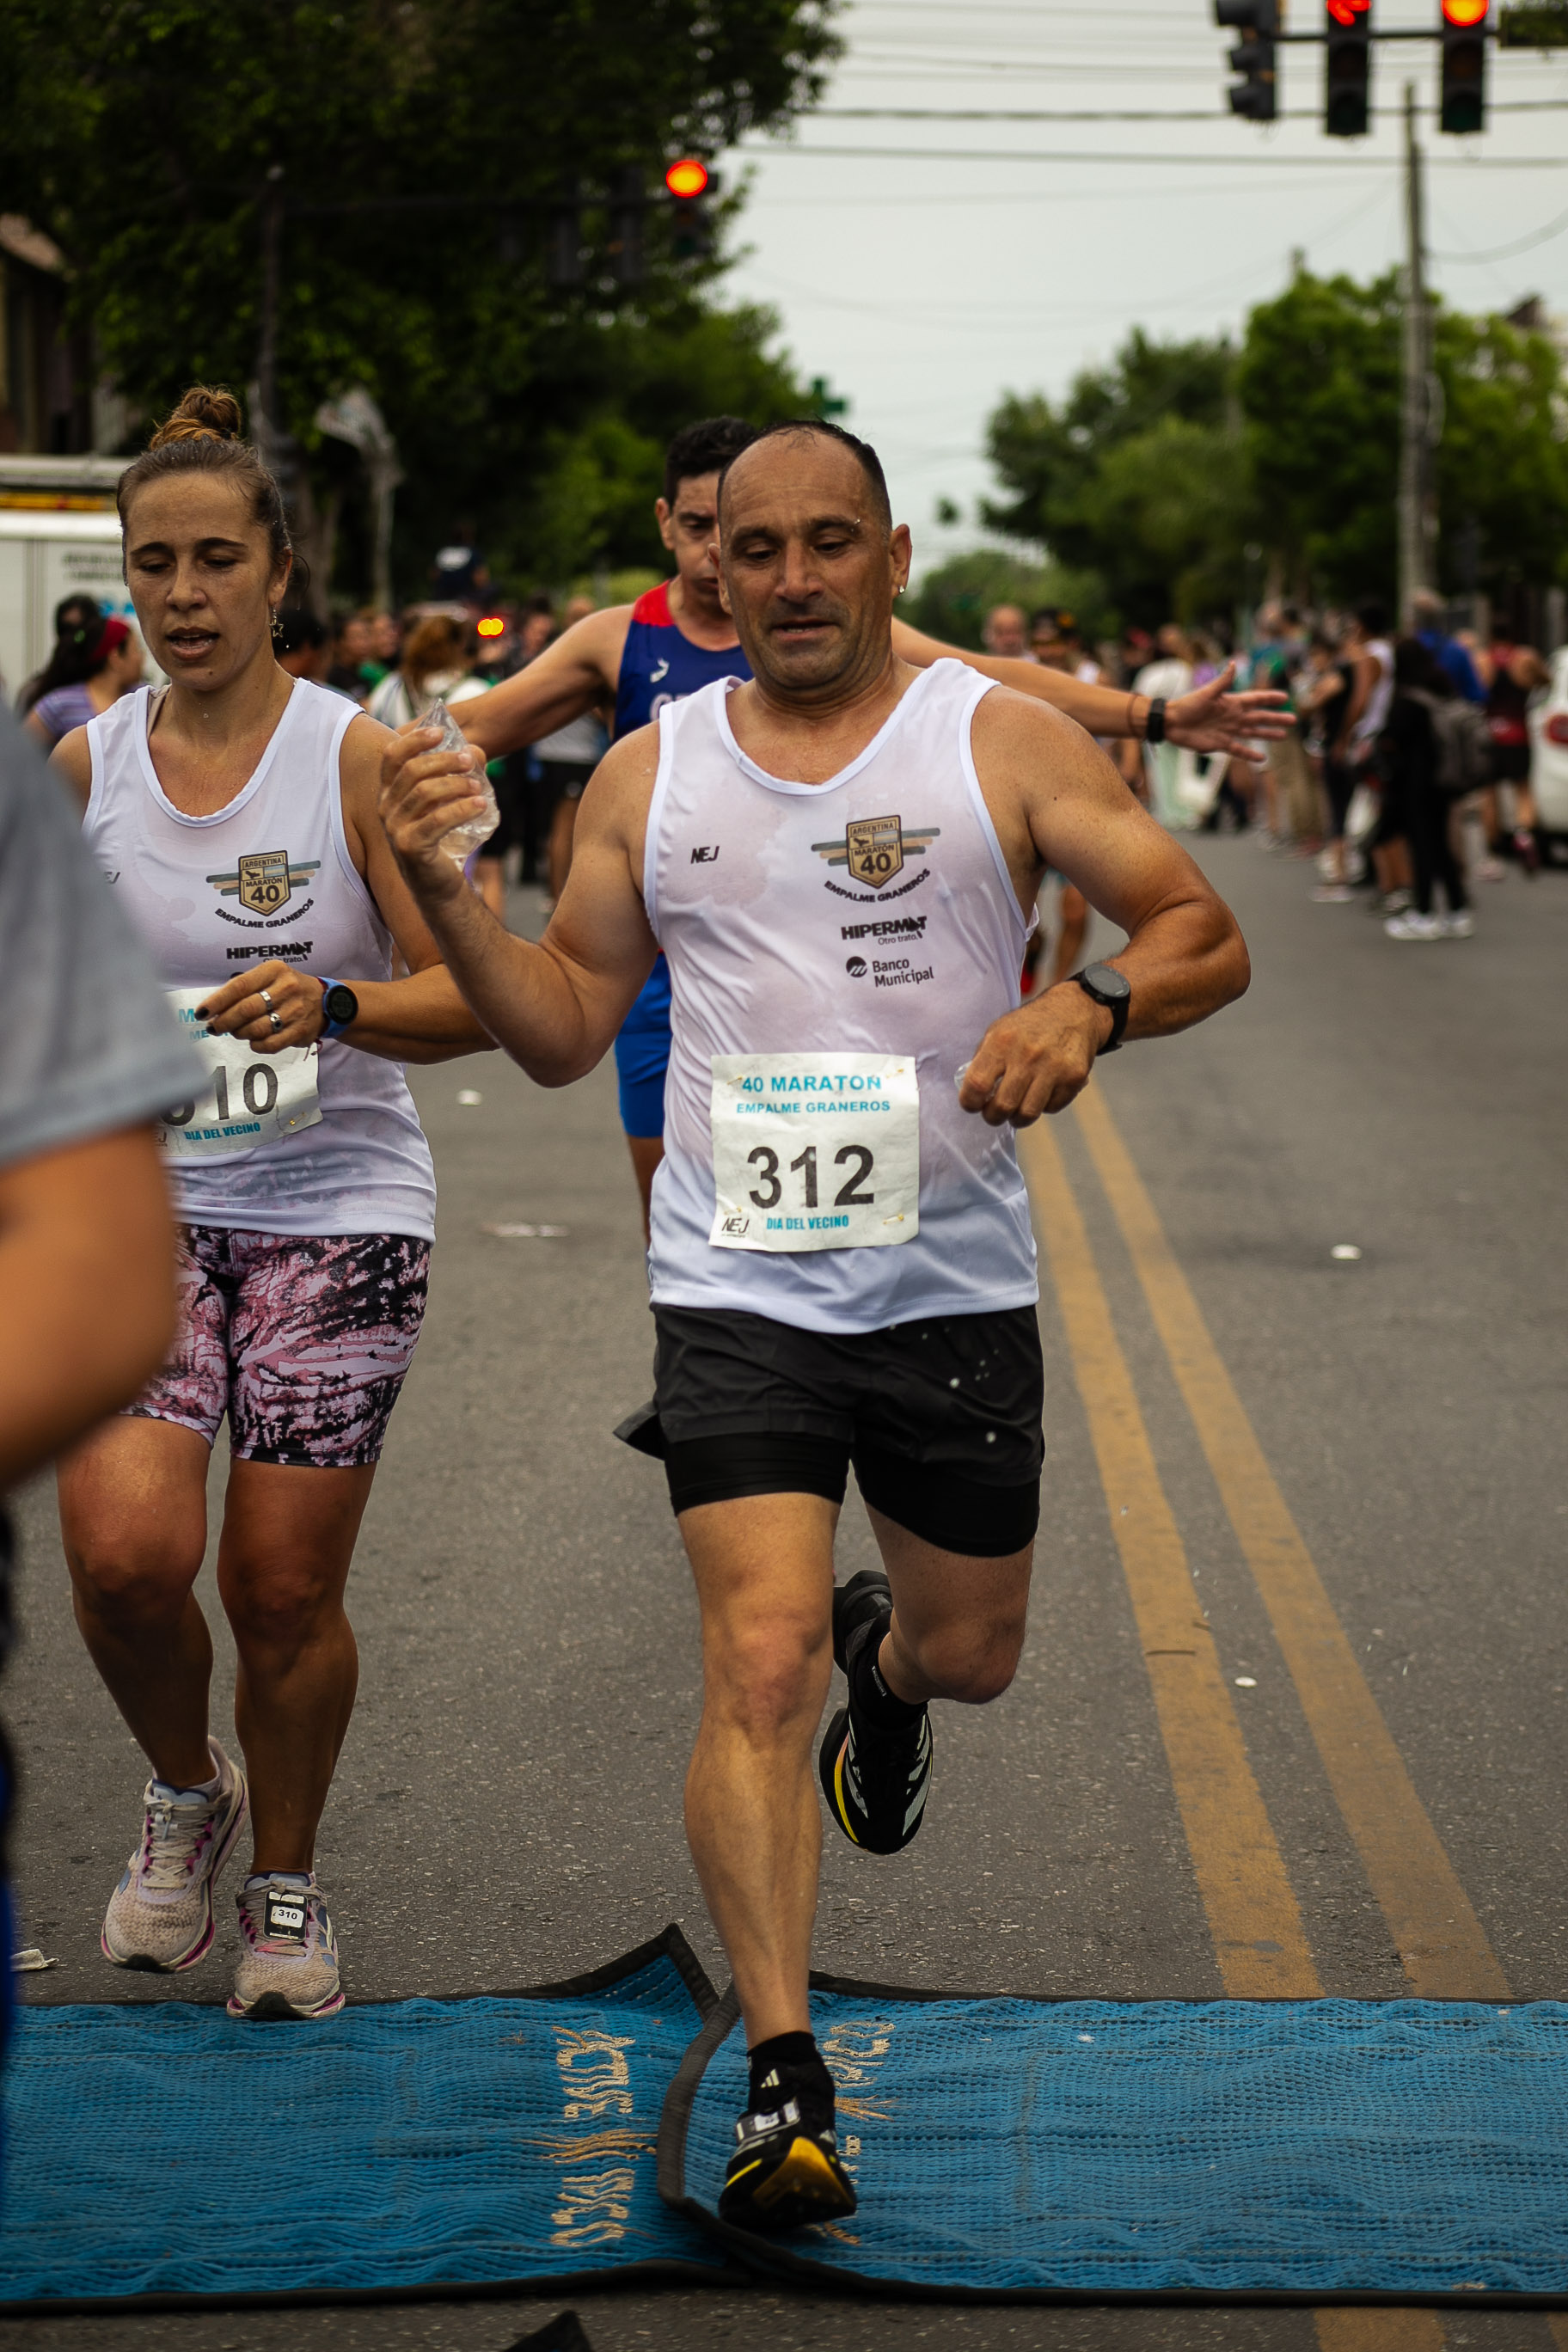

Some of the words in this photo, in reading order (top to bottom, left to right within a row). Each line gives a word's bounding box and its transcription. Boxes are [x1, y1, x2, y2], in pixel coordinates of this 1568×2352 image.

[852, 822, 894, 835] ARGENTINA
[244, 857, 282, 868] ARGENTINA
[690, 845, 720, 864] NEJ
[860, 853, 891, 875] 40
[824, 880, 876, 903] EMPALME
[877, 867, 931, 902] GRANEROS
[250, 885, 280, 904] 40
[214, 908, 264, 928] EMPALME
[265, 897, 315, 928] GRANEROS
[877, 936, 897, 946] Otro
[872, 959, 910, 973] Banco
[874, 966, 934, 988] Municipal
[742, 1076, 763, 1093] 40
[771, 1075, 882, 1093] MARATON
[736, 1102, 801, 1114] EMPALME
[805, 1100, 891, 1113] GRANEROS
[184, 1130, 203, 1141] DIA
[203, 1128, 222, 1140] DEL
[222, 1122, 261, 1136] VECINO
[746, 1144, 875, 1210] 312
[721, 1217, 750, 1234] NEJ
[766, 1217, 782, 1230] DIA
[786, 1216, 805, 1230] DEL
[807, 1215, 849, 1229] VECINO
[278, 1908, 298, 1920] 310
